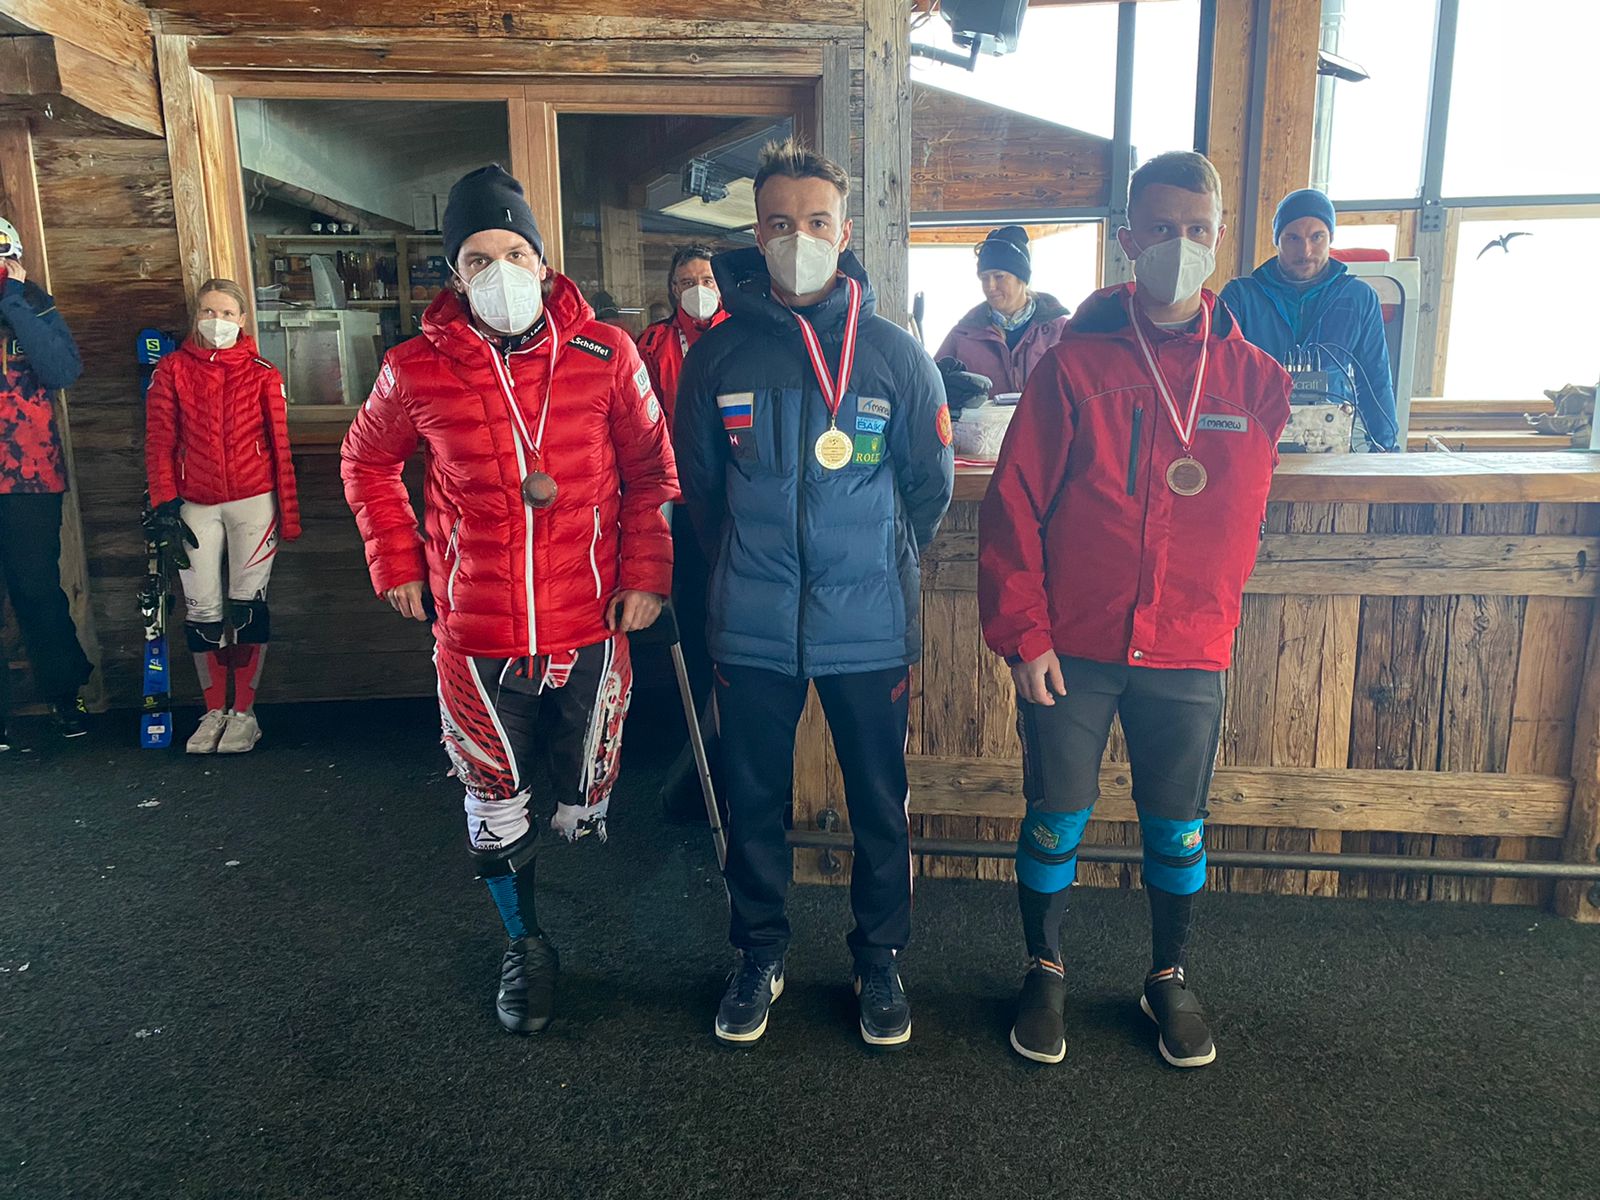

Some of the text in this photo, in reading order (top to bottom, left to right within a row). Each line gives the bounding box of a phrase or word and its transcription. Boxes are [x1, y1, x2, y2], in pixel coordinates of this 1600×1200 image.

[148, 340, 158, 350] S
[575, 337, 609, 356] Schöffel
[1295, 380, 1319, 390] craft
[856, 452, 881, 462] ROLE
